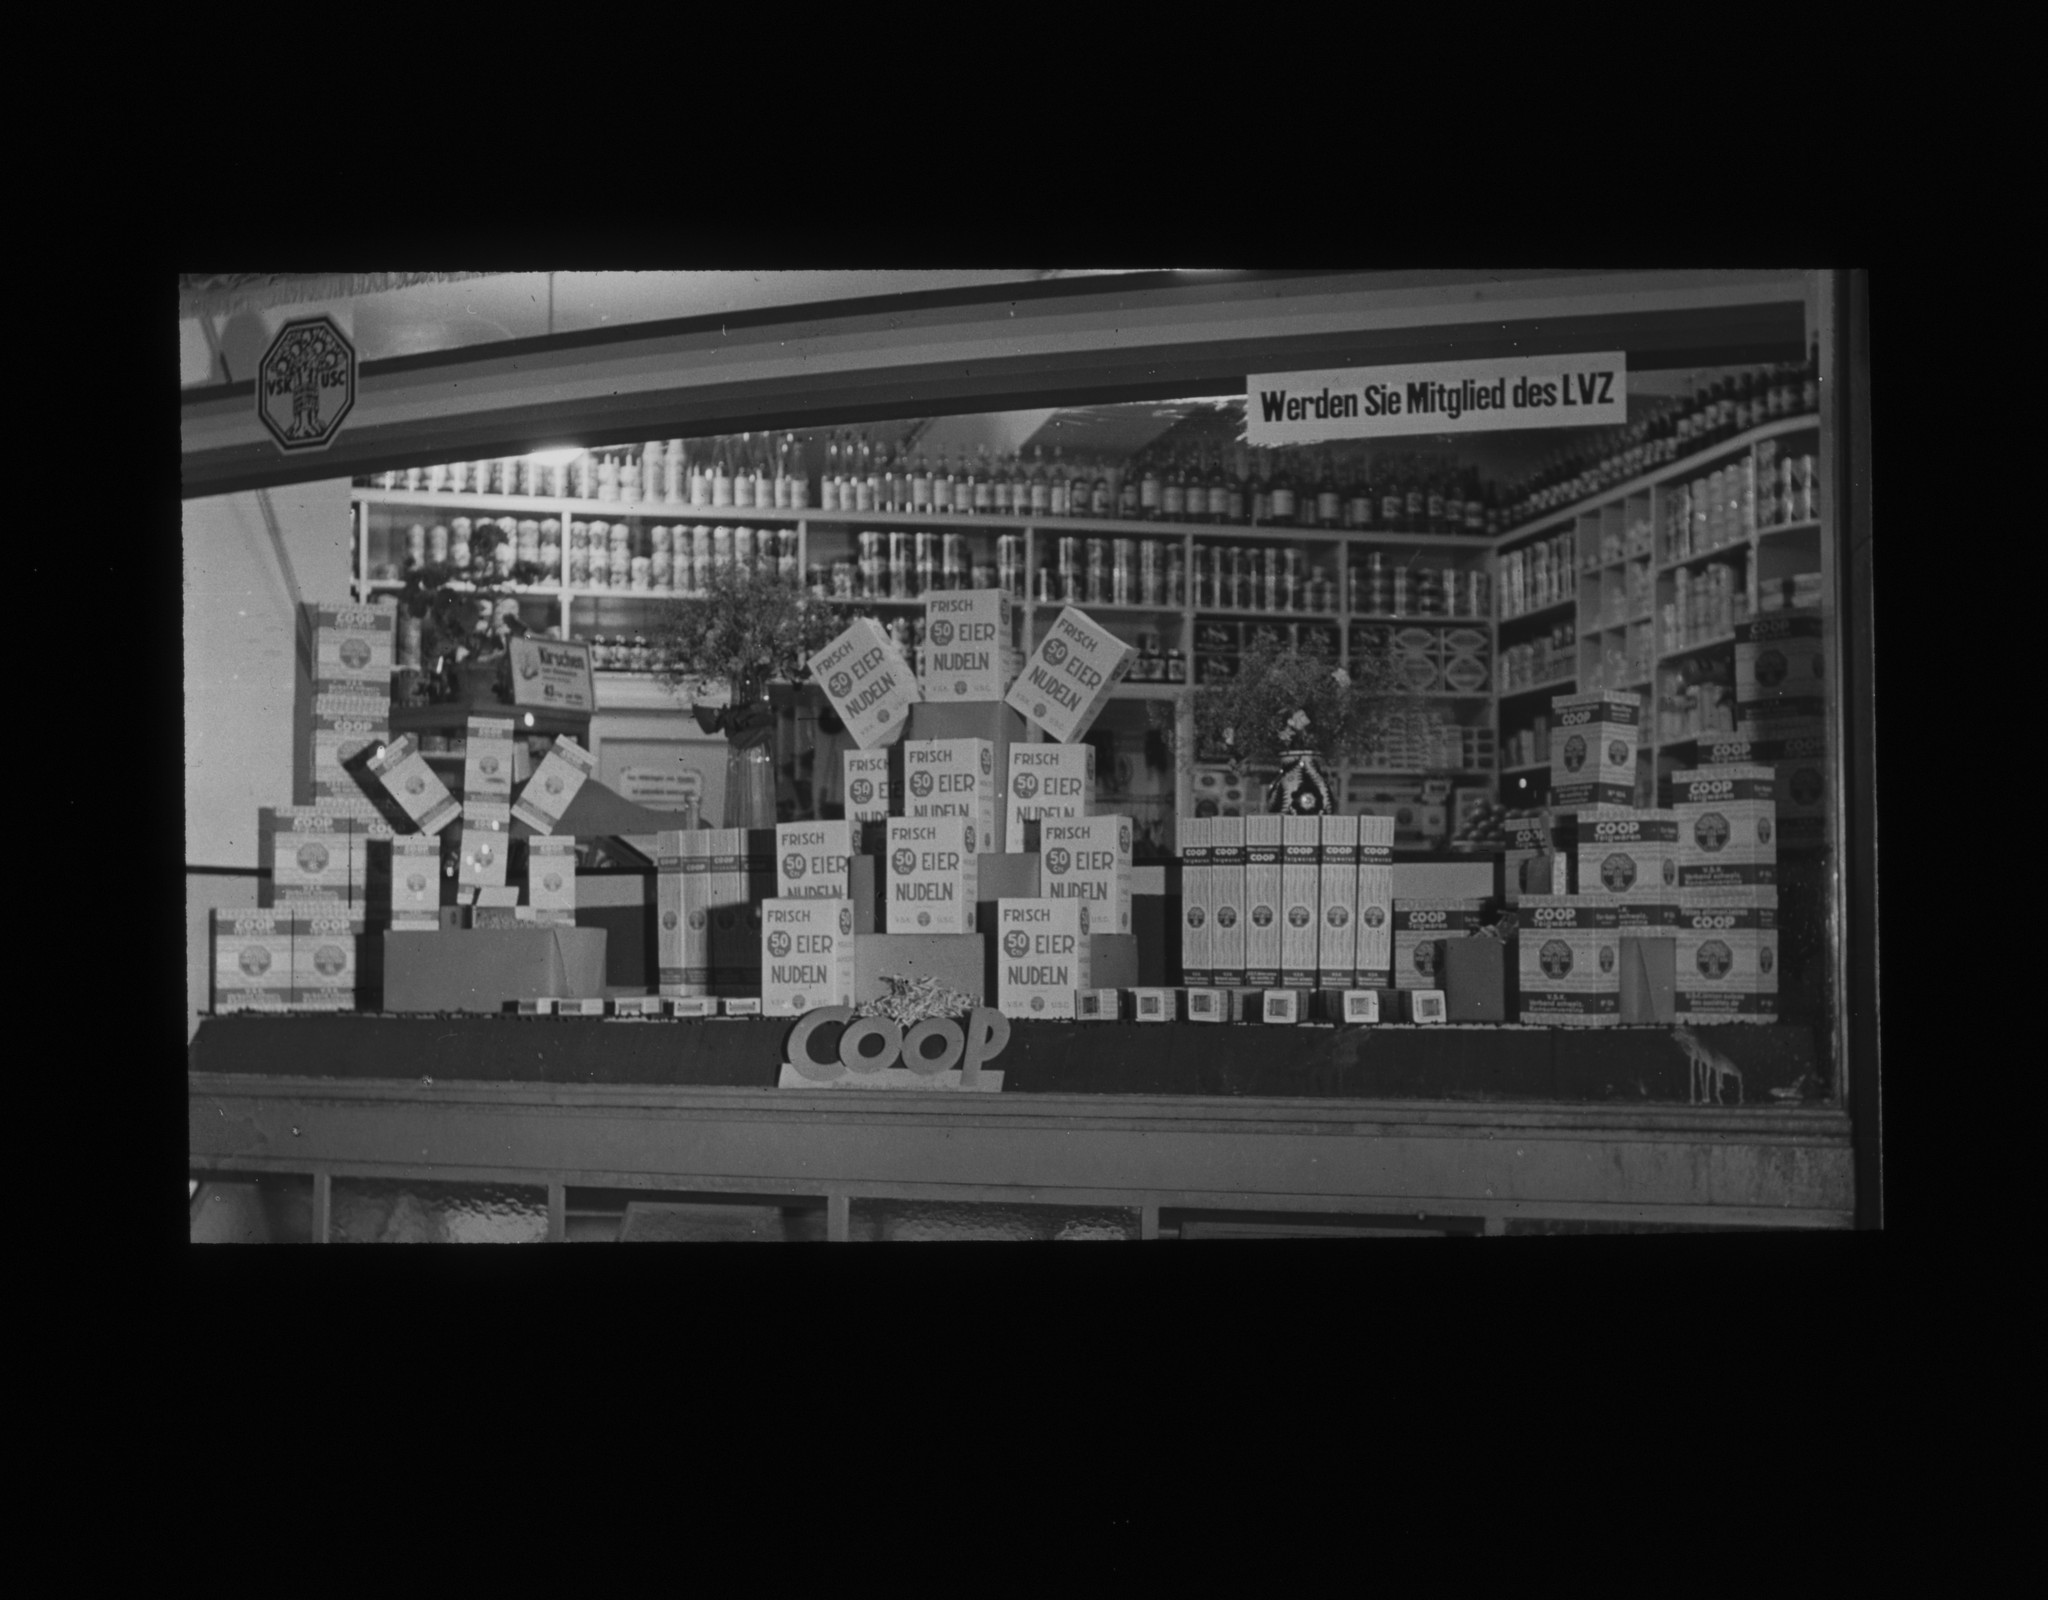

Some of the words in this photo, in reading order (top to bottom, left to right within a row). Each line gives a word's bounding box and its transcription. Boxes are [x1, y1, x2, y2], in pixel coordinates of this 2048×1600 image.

[267, 377, 292, 396] VSK
[321, 370, 345, 388] USC
[1261, 388, 1358, 422] Werden
[1365, 384, 1401, 416] Sie
[1407, 377, 1505, 419] Mitglied
[1513, 376, 1557, 408] des
[1563, 371, 1614, 405] LVZ
[931, 600, 973, 612] FRISCH
[933, 623, 951, 637] 50
[959, 623, 996, 641] EIER
[1057, 618, 1098, 652] FRISCH
[816, 641, 854, 676] FRISCH
[934, 652, 989, 670] NUDELN
[1047, 640, 1065, 660] 50
[1066, 656, 1102, 690] EIER
[832, 674, 849, 692] 50
[851, 647, 885, 680] EIER
[845, 671, 896, 719] NUDELN
[1028, 665, 1082, 712] NUDELN
[1562, 711, 1591, 726] COOP
[334, 721, 372, 731] COOP
[1713, 743, 1751, 755] COOP
[909, 750, 952, 763] FRISCH
[1014, 753, 1059, 765] FRISCH
[853, 781, 870, 795] 50
[913, 774, 931, 787] 50
[938, 774, 975, 792] EIER
[1018, 776, 1035, 789] 50
[1044, 778, 1082, 796] EIER
[1690, 780, 1733, 793] COOP
[1688, 793, 1734, 801] Teigwaren
[892, 828, 936, 840] FRISCH
[1046, 827, 1090, 839] FRISCH
[1596, 822, 1639, 834] COOP
[782, 833, 824, 845] FRISCH
[1594, 834, 1641, 842] Teigwaren
[1186, 848, 1207, 856] COOP
[1250, 853, 1275, 861] COOP
[1287, 846, 1314, 855] COOP
[1326, 846, 1353, 855] COOP
[1363, 847, 1390, 855] COOP
[714, 857, 735, 865] COOP
[786, 857, 804, 870] 50
[812, 855, 848, 874] EIER
[896, 852, 913, 866] 50
[922, 852, 960, 871] EIER
[1050, 851, 1067, 865] 50
[1076, 852, 1114, 870] EIER
[896, 883, 953, 901] NUDELN
[1050, 882, 1107, 900] NUDELN
[768, 910, 811, 922] FRISCH
[1004, 909, 1050, 921] FRISCH
[1409, 911, 1447, 923] COOP
[1535, 909, 1576, 920] COOP
[311, 920, 349, 929] COOP
[1533, 920, 1577, 929] Teigwaren
[1692, 916, 1736, 928] COOP
[771, 934, 788, 948] 50
[797, 935, 833, 953] EIER
[1008, 933, 1026, 948] 50
[1035, 935, 1075, 953] EIER
[772, 966, 826, 983] NUDELN
[1008, 966, 1068, 985] NUDELN
[788, 1005, 1011, 1087] COOP
